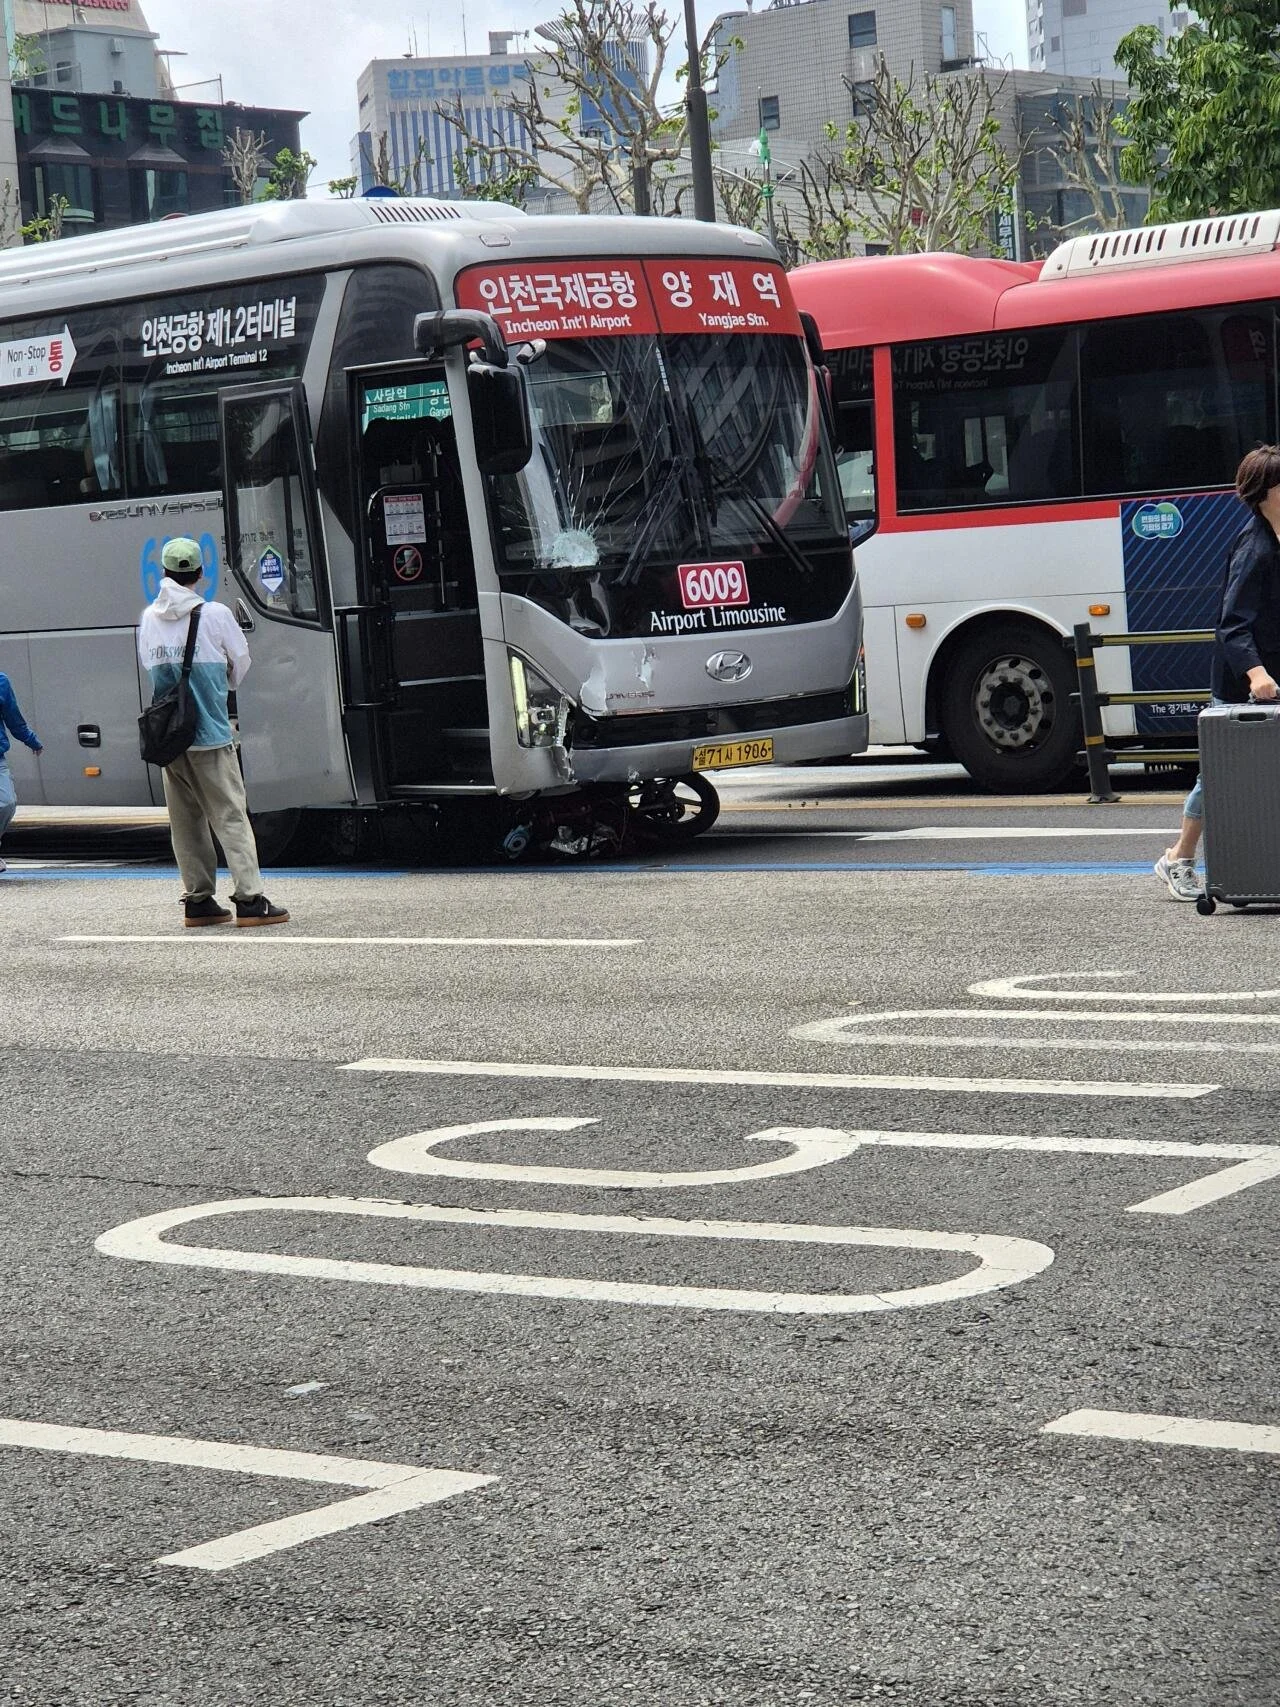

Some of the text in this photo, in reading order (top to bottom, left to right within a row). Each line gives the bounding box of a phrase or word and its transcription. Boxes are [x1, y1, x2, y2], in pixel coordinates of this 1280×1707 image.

[479, 269, 638, 316] 인천국제공항
[504, 314, 632, 334] Incheon Int'l Airport
[698, 312, 769, 329] Yangjae Stn.
[141, 310, 205, 358] 인천공항
[7, 345, 46, 364] Non-Stop
[166, 361, 192, 375] Incheon
[205, 354, 228, 370] Airport
[228, 350, 258, 366] Terminal
[374, 386, 407, 403] 사당역
[142, 532, 219, 604] 69
[685, 567, 743, 602] 6009
[650, 602, 787, 635] Airport Limousine
[1151, 704, 1166, 714] The
[1167, 703, 1199, 715] 경기패스
[736, 742, 768, 761] 1906
